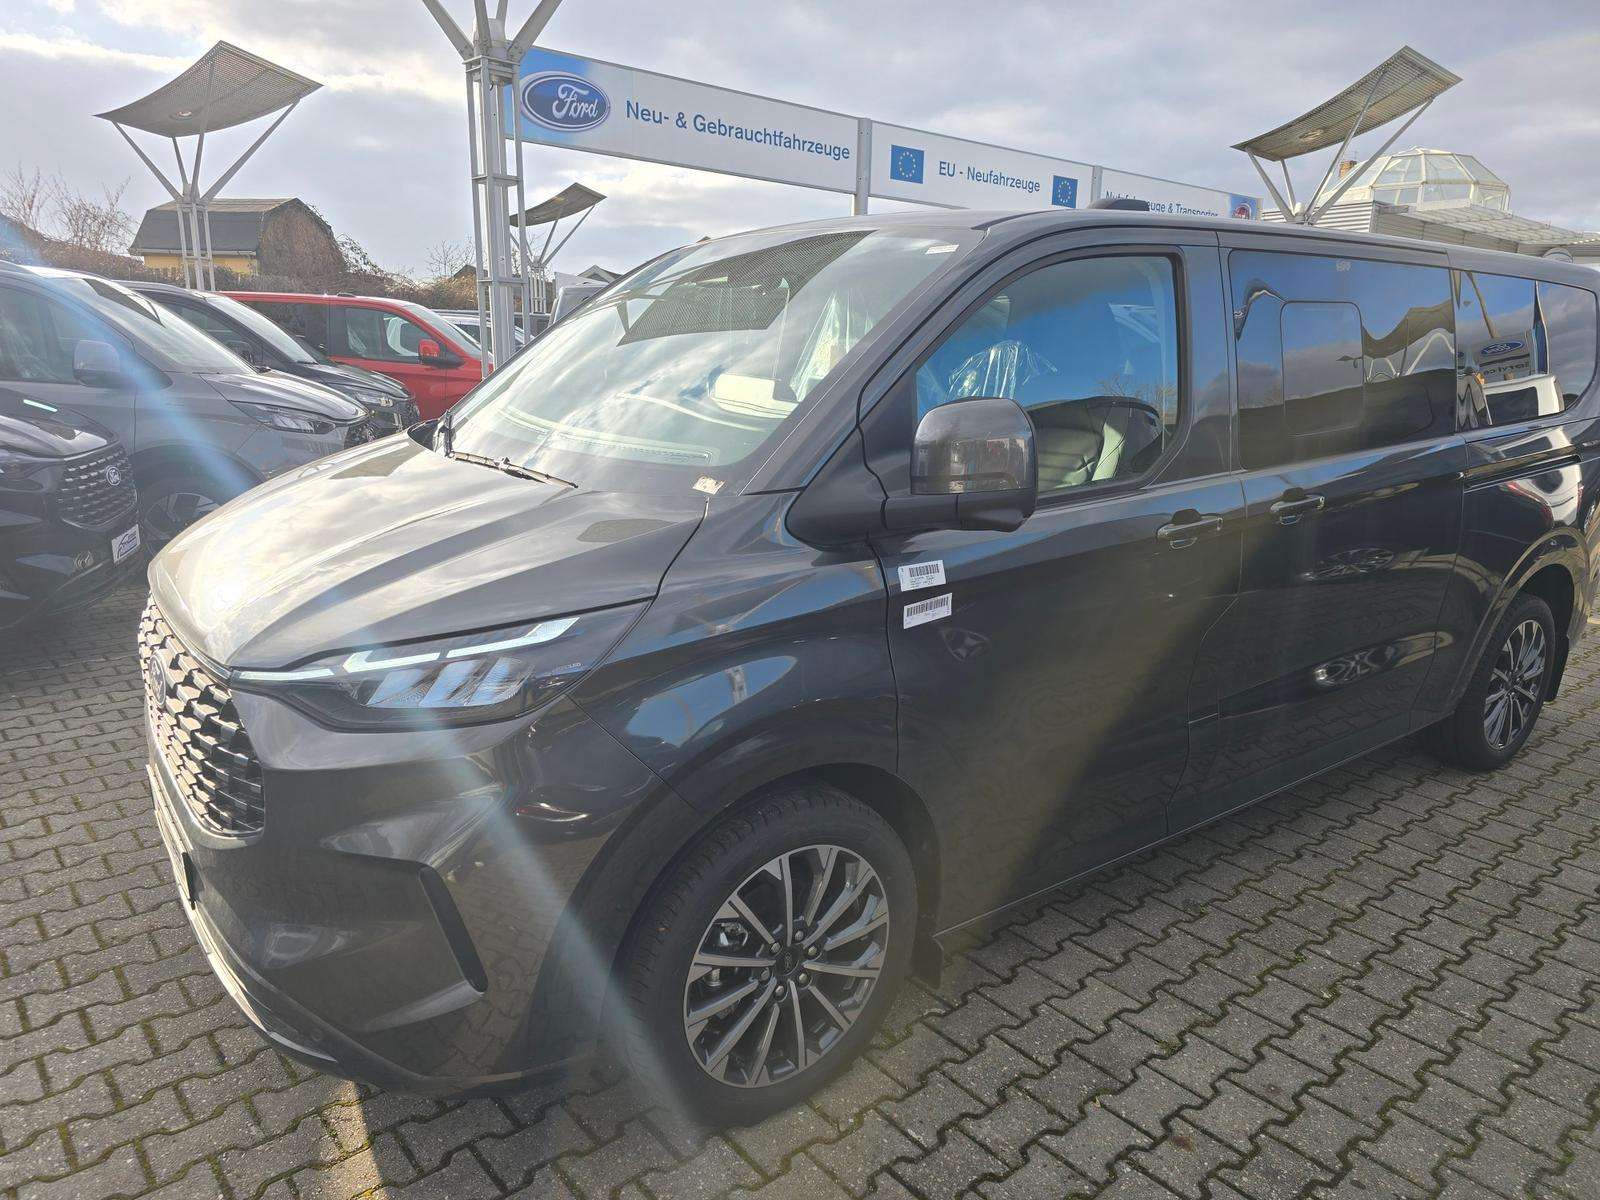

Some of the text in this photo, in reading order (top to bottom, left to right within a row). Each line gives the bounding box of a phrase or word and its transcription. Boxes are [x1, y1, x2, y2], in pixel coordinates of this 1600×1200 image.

[552, 83, 599, 119] Ford
[626, 100, 851, 161] Neu- & Gebrauchtfahrzeuge
[938, 160, 956, 178] EU
[967, 166, 1041, 193] Neufahrzeuge
[1167, 202, 1174, 214] &
